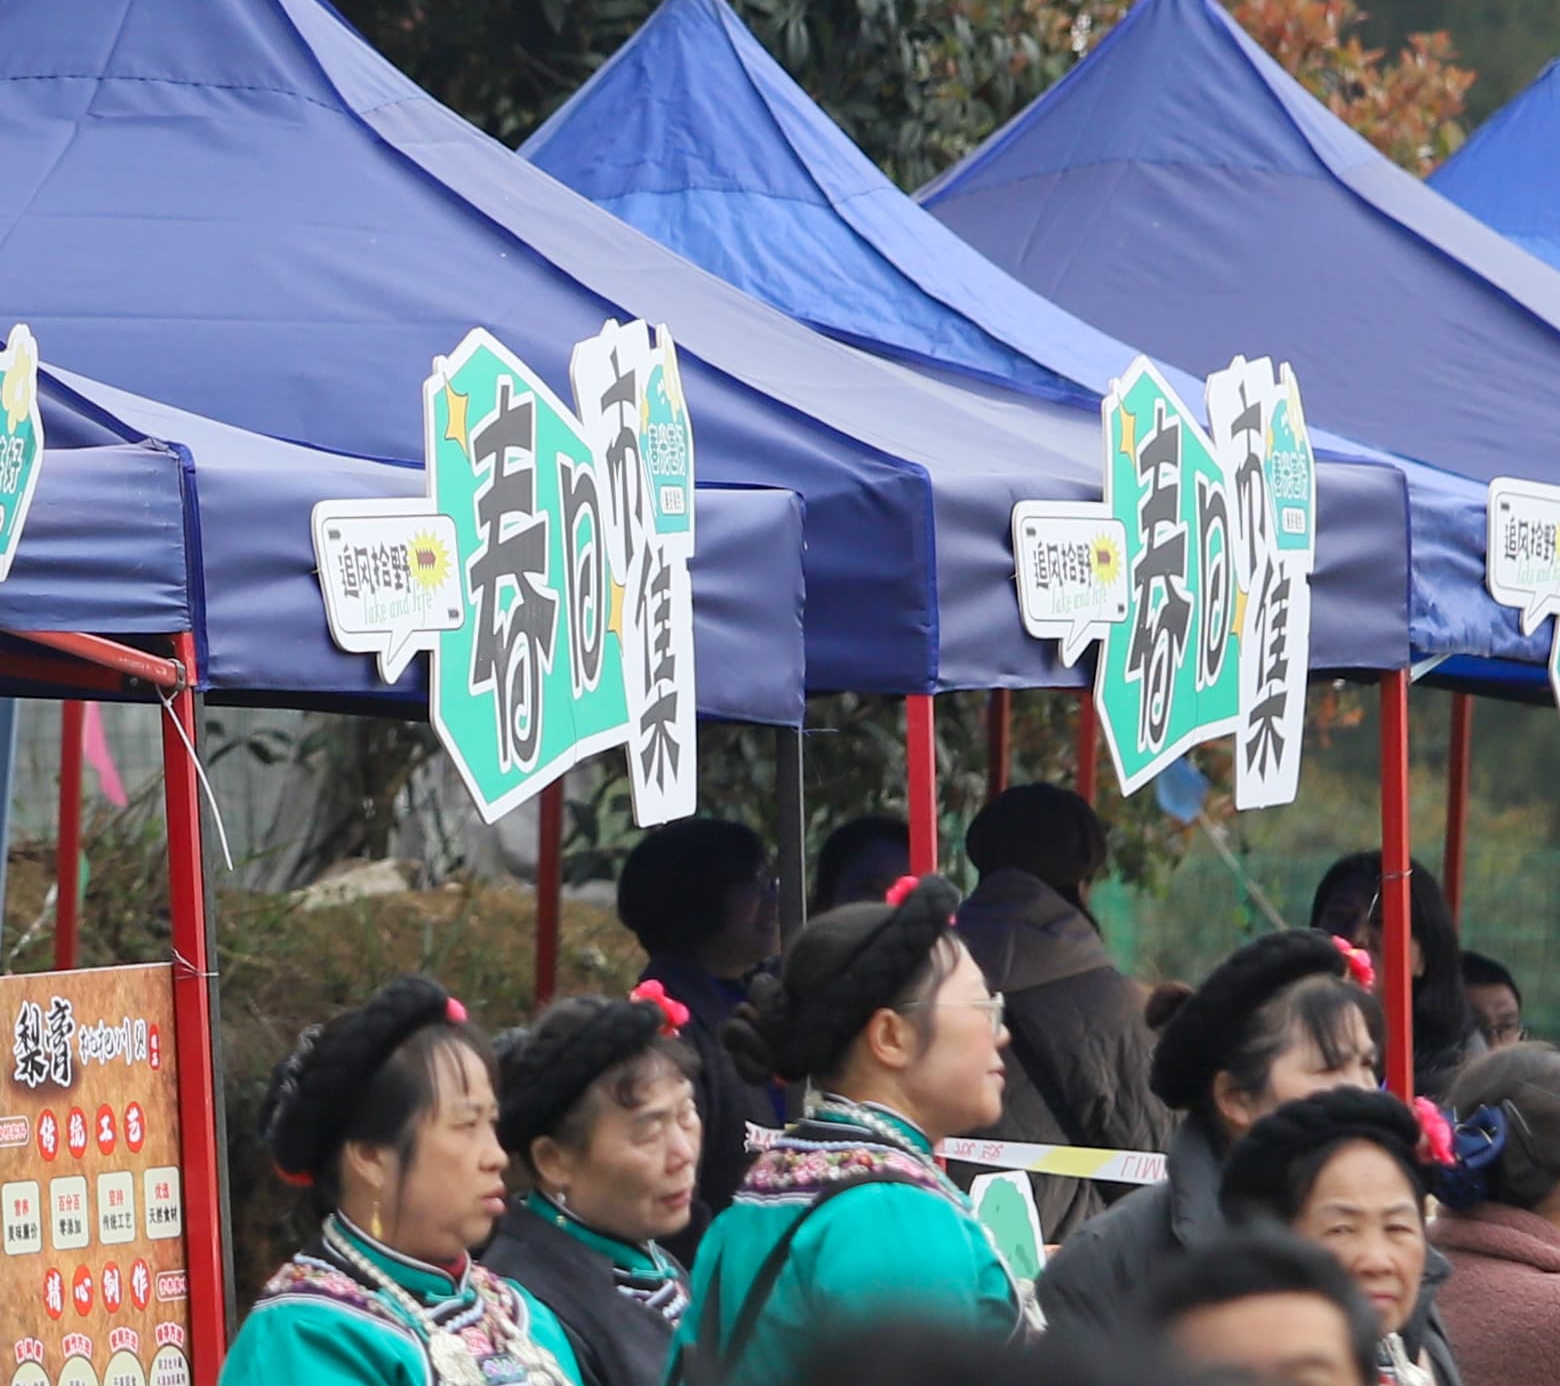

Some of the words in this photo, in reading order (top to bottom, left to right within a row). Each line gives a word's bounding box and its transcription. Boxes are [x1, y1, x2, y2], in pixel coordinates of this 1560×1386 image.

[338, 542, 411, 598] 追风拾野
[470, 384, 605, 766] 春日
[601, 347, 683, 796] 市集
[1033, 541, 1092, 589] 追风拾野
[1125, 408, 1229, 744] 春日
[1230, 377, 1290, 782] 市集
[14, 997, 75, 1088] 梨膏
[58, 1194, 81, 1211] 百分百
